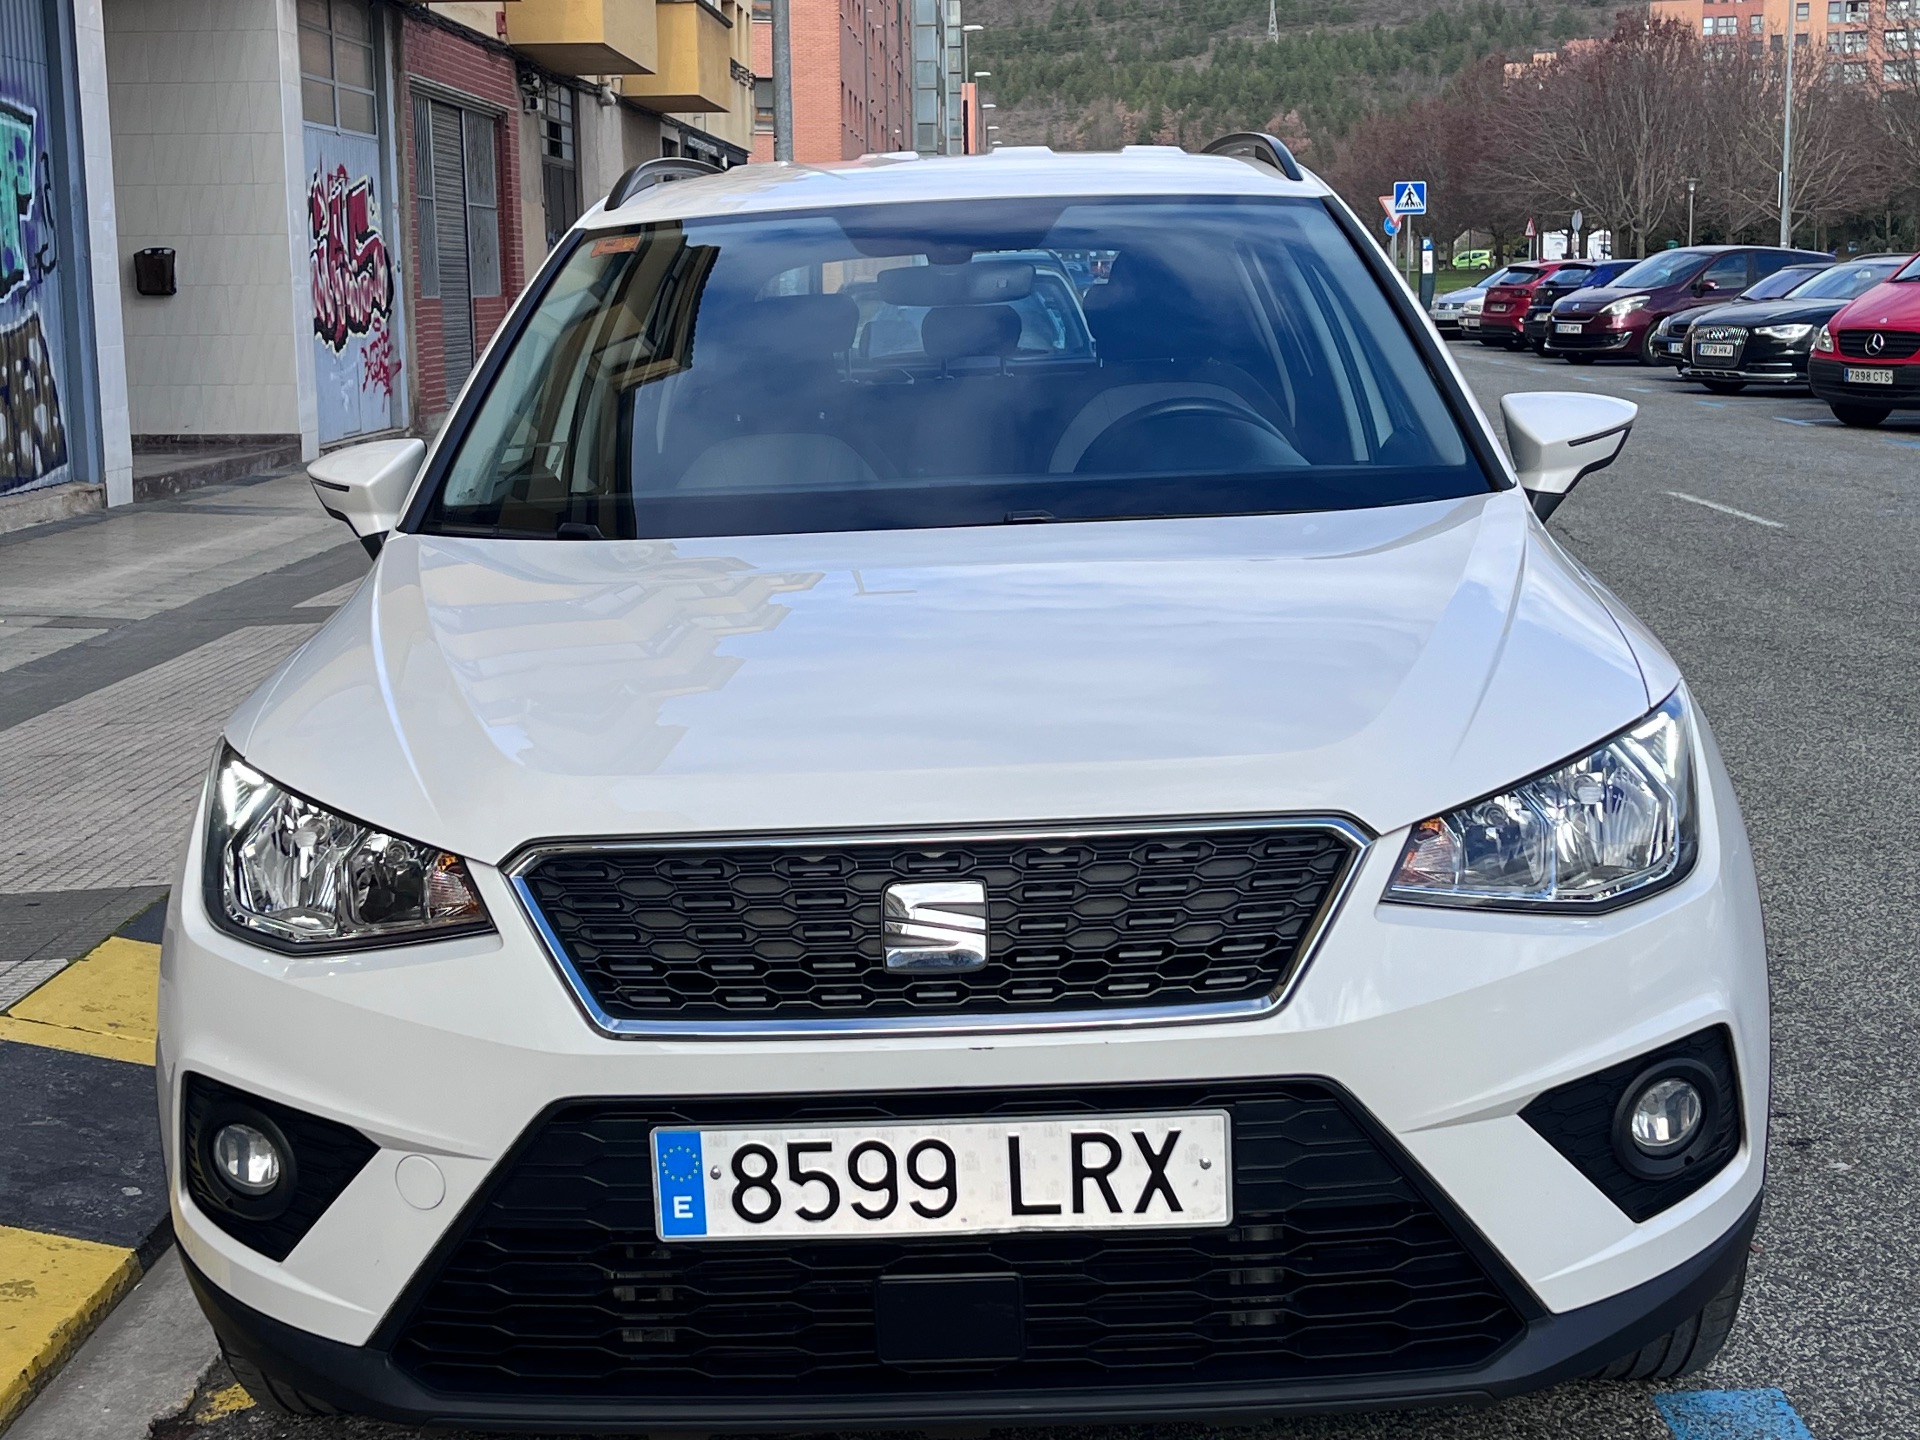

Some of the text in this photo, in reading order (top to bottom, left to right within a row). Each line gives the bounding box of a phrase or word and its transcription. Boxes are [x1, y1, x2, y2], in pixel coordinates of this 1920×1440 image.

[1423, 239, 1431, 249] P
[1849, 370, 1890, 382] 7898 CTS
[673, 1127, 1184, 1224] E 8599 LRX
